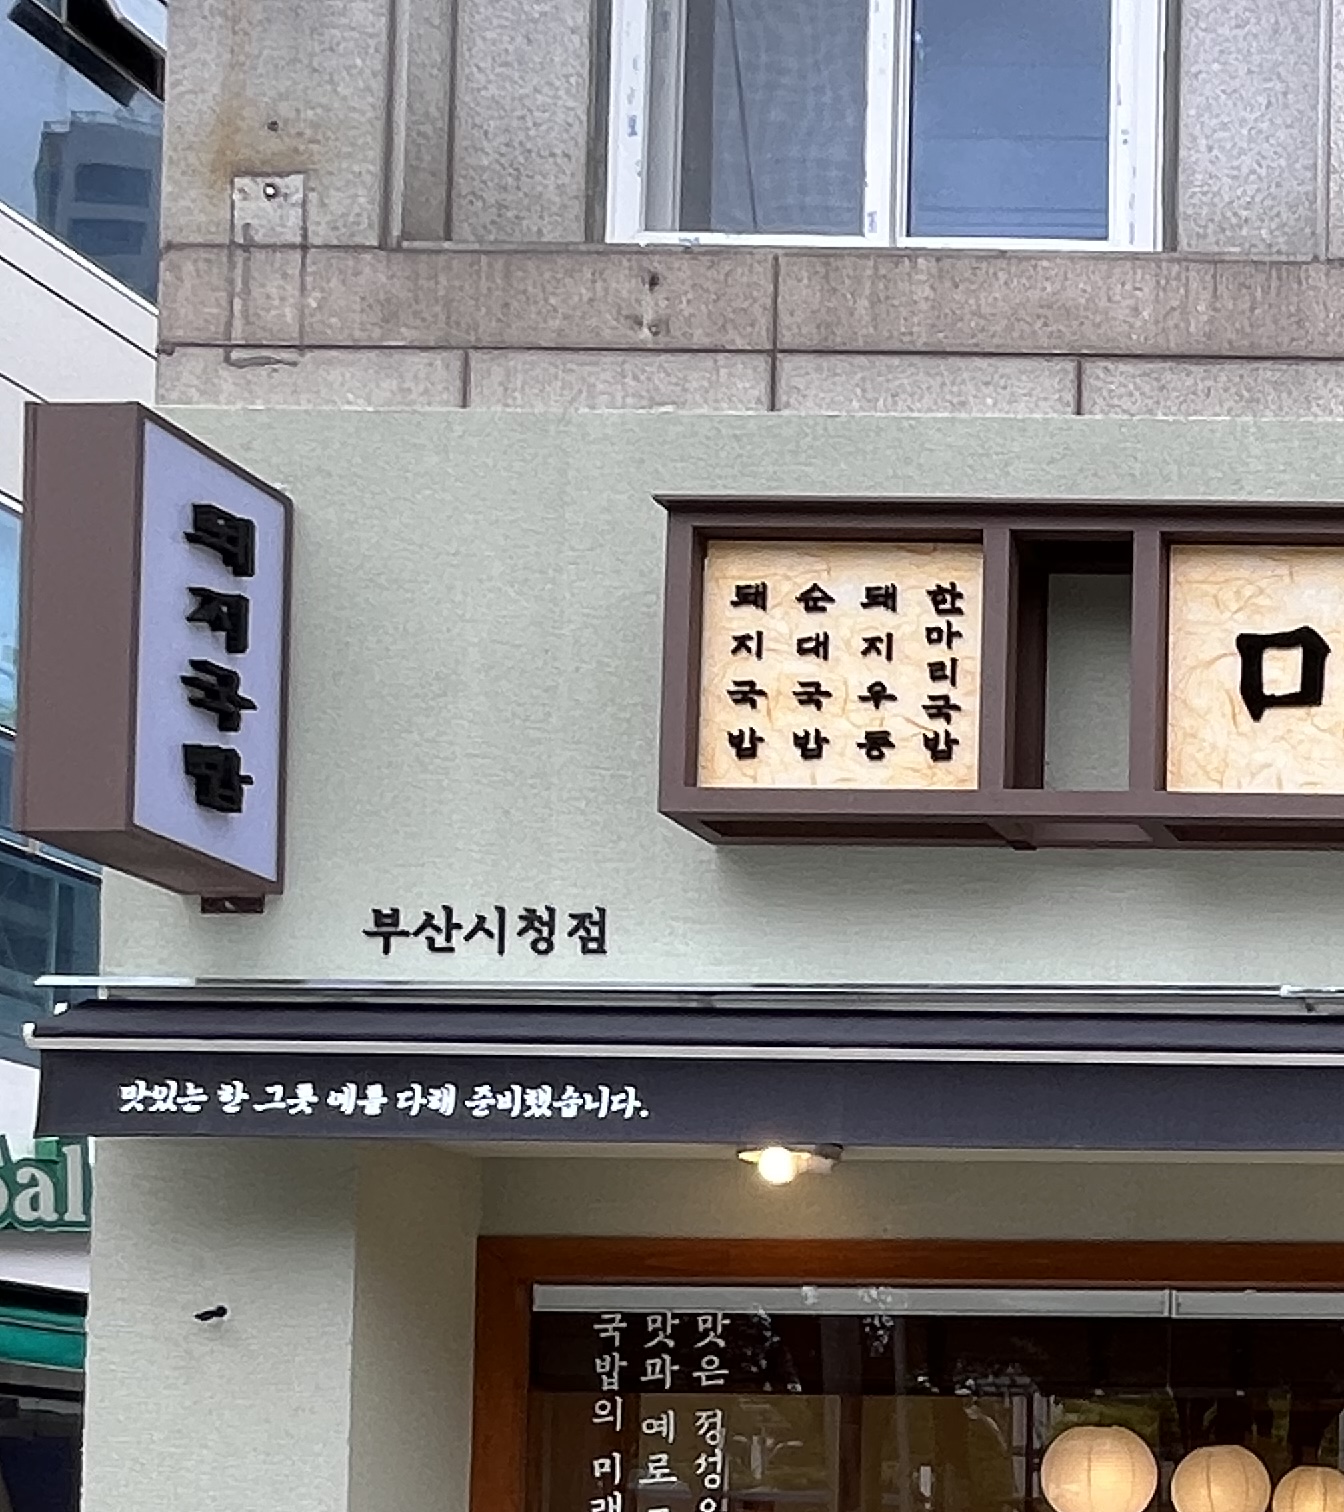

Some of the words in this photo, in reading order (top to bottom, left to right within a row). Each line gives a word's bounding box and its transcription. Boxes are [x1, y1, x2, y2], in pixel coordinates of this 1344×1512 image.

[180, 503, 257, 814] 돼지국밥
[726, 582, 768, 761] 돼지국밥
[792, 582, 836, 761] 순대국밥
[856, 582, 898, 762] 돼지우동
[921, 581, 964, 763] 한마리국밥
[362, 904, 608, 956] 부산시청점
[119, 1079, 209, 1113] 맛있는
[217, 1080, 250, 1114] 한
[253, 1082, 319, 1115] 그릇
[464, 1084, 649, 1119] 준비했습니다.
[0, 1143, 87, 1222] al
[592, 1313, 628, 1432] 국밥의
[640, 1311, 680, 1390] 맛과
[692, 1312, 730, 1387] 맛은
[638, 1410, 678, 1484] 예로
